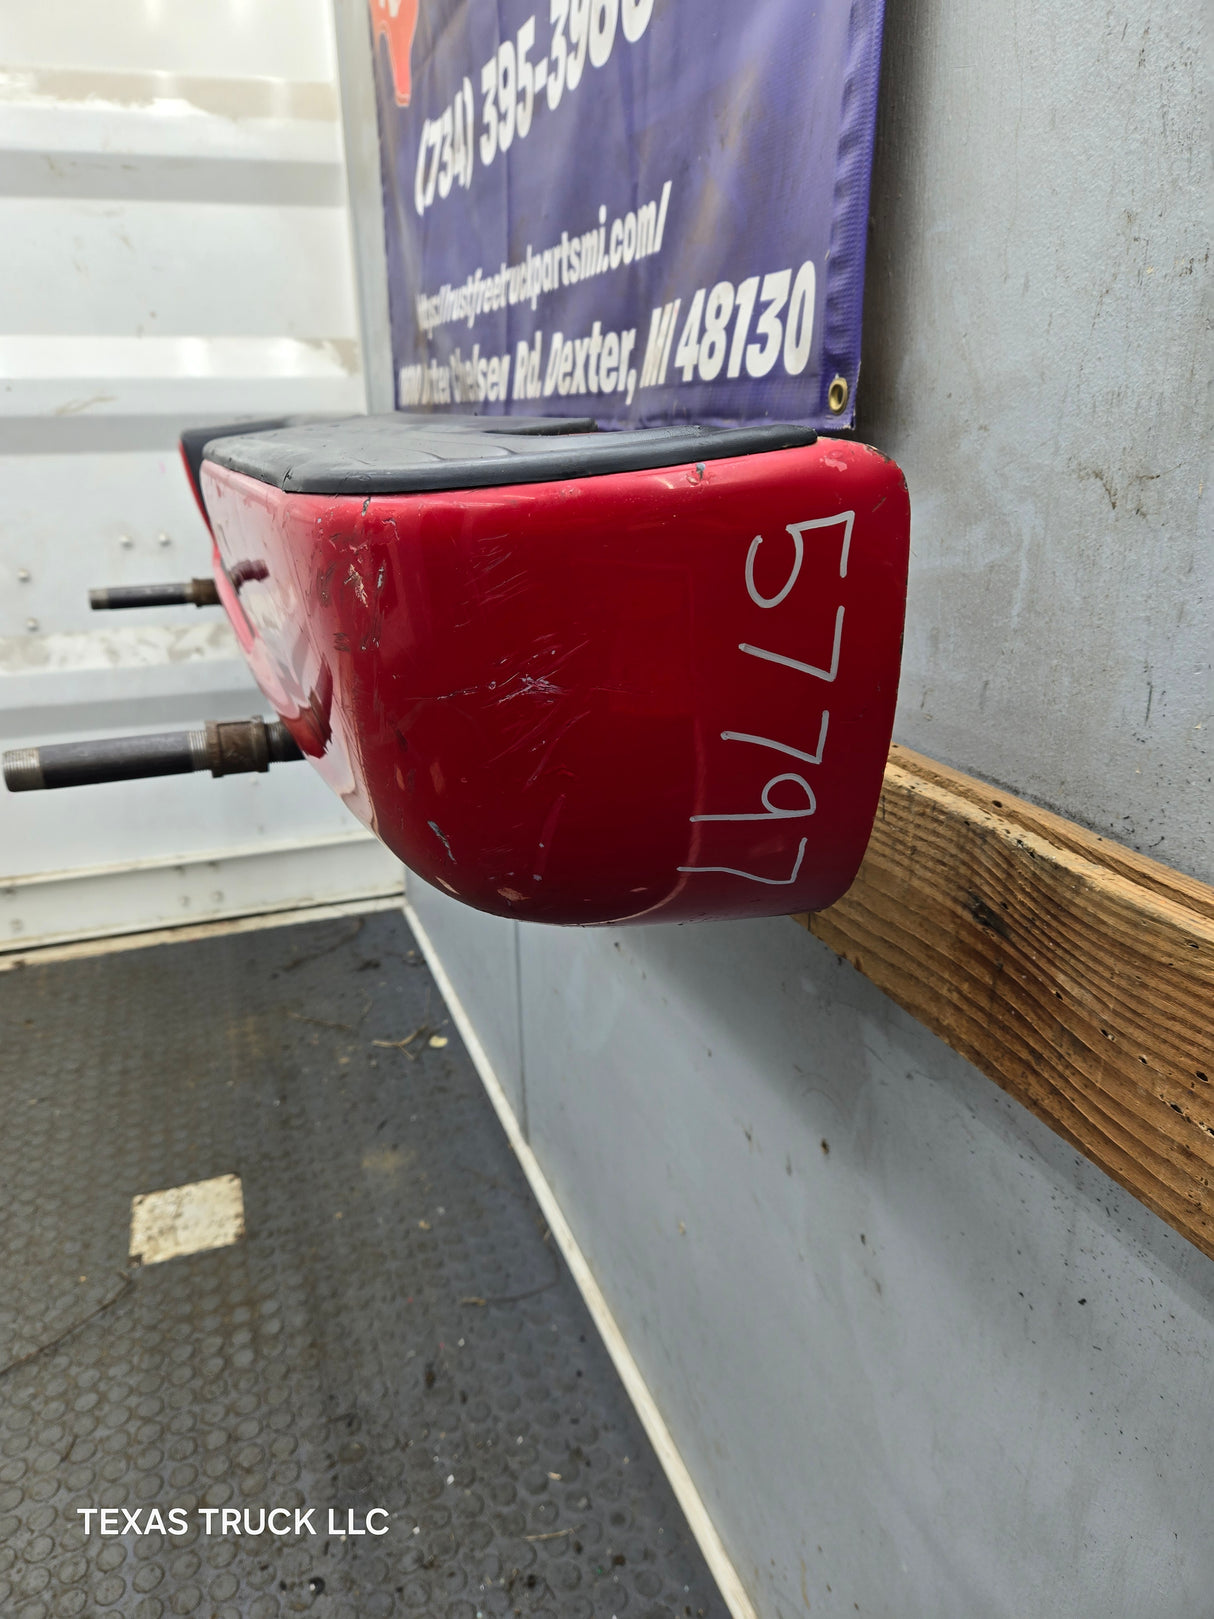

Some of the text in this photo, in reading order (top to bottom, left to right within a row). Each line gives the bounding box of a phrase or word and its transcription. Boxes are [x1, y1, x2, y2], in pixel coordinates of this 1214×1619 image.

[414, 77, 474, 217] (734)
[543, 321, 637, 406] Dexter,
[640, 298, 681, 388] MI
[675, 261, 816, 382] 48130
[677, 511, 855, 885] 57797
